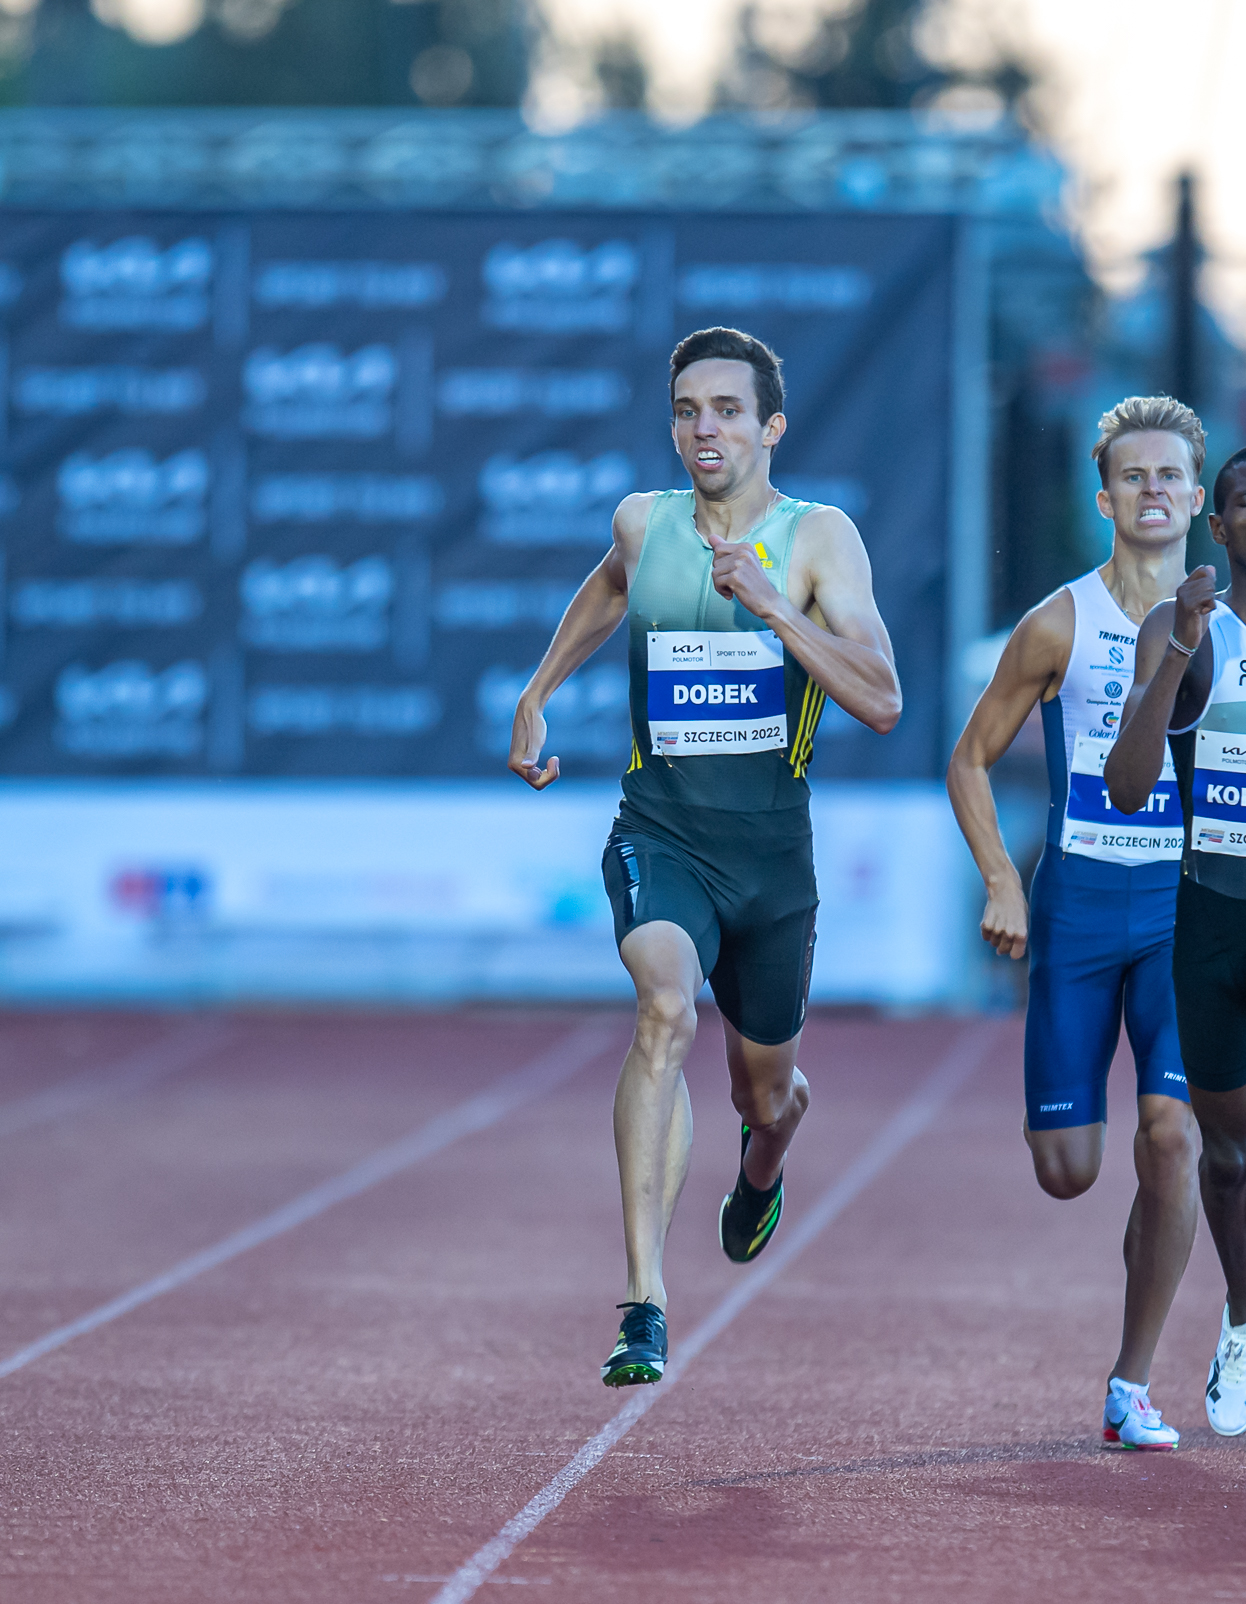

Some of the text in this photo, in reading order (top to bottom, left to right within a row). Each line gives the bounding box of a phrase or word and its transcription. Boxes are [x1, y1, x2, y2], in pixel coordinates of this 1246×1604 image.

[1099, 630, 1136, 646] TRIMTEX
[673, 684, 759, 705] DOBEK
[684, 730, 748, 743] SZCZECIN
[751, 726, 781, 741] 2022
[1089, 729, 1112, 739] Color
[1101, 789, 1171, 813] TIT
[1101, 835, 1160, 849] SZCZECIN
[1163, 838, 1184, 849] 202
[1163, 1071, 1187, 1084] TRIMT
[1039, 1102, 1074, 1113] TRIMTEX
